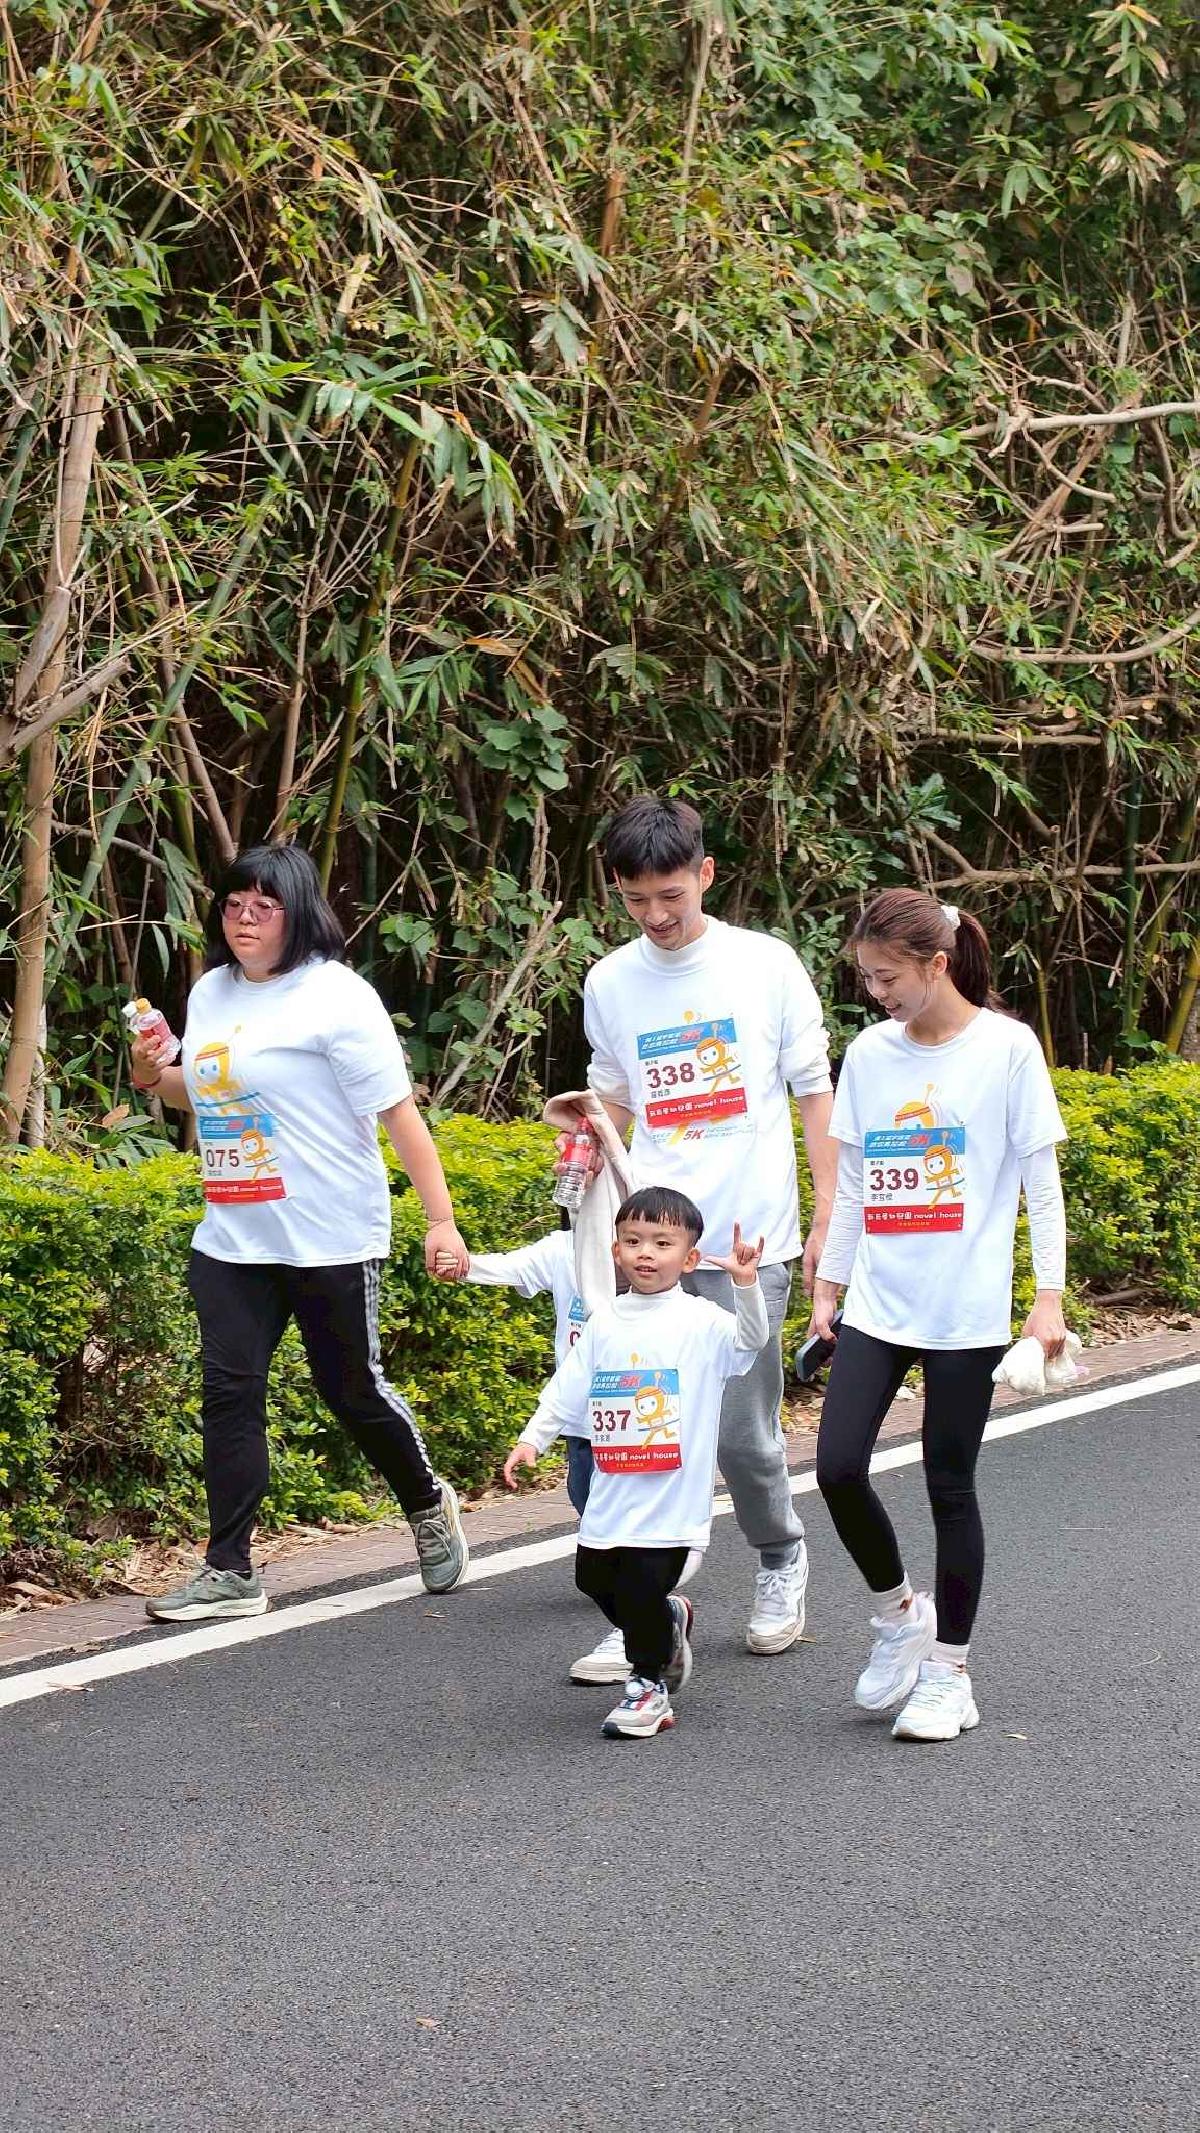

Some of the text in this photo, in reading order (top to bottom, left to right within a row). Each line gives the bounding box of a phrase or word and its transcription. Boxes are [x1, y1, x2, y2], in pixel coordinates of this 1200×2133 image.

[646, 1063, 695, 1088] 338
[683, 1129, 705, 1140] 5K
[206, 1149, 240, 1167] 075
[870, 1168, 919, 1191] 339
[592, 1410, 631, 1432] 337
[629, 1452, 650, 1460] novel
